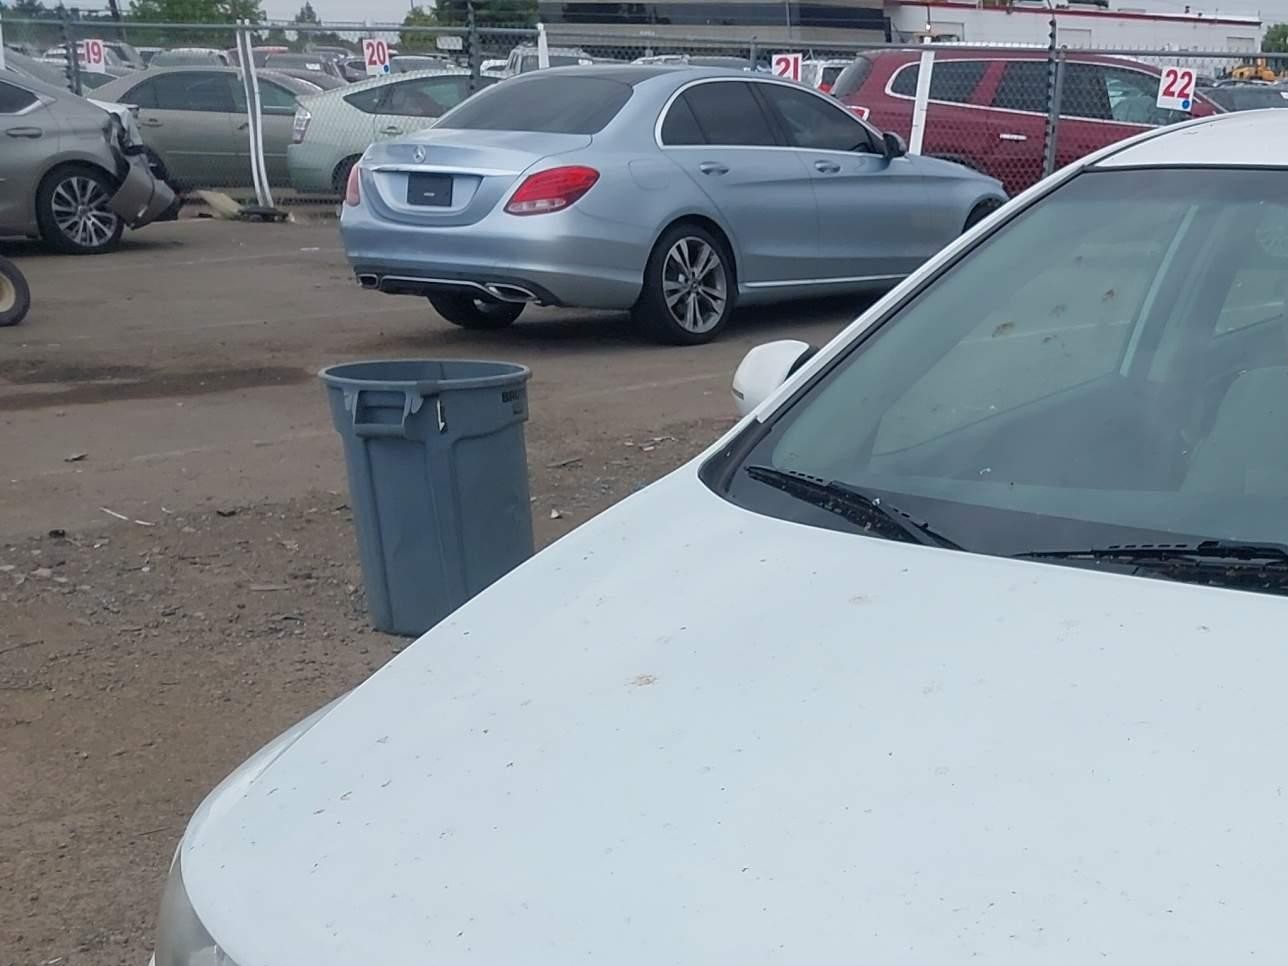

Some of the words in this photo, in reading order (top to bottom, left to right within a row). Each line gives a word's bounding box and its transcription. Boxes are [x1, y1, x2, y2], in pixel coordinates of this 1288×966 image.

[85, 41, 102, 64] 19
[366, 41, 386, 66] 20
[775, 56, 799, 81] 21
[1162, 69, 1193, 99] 22
